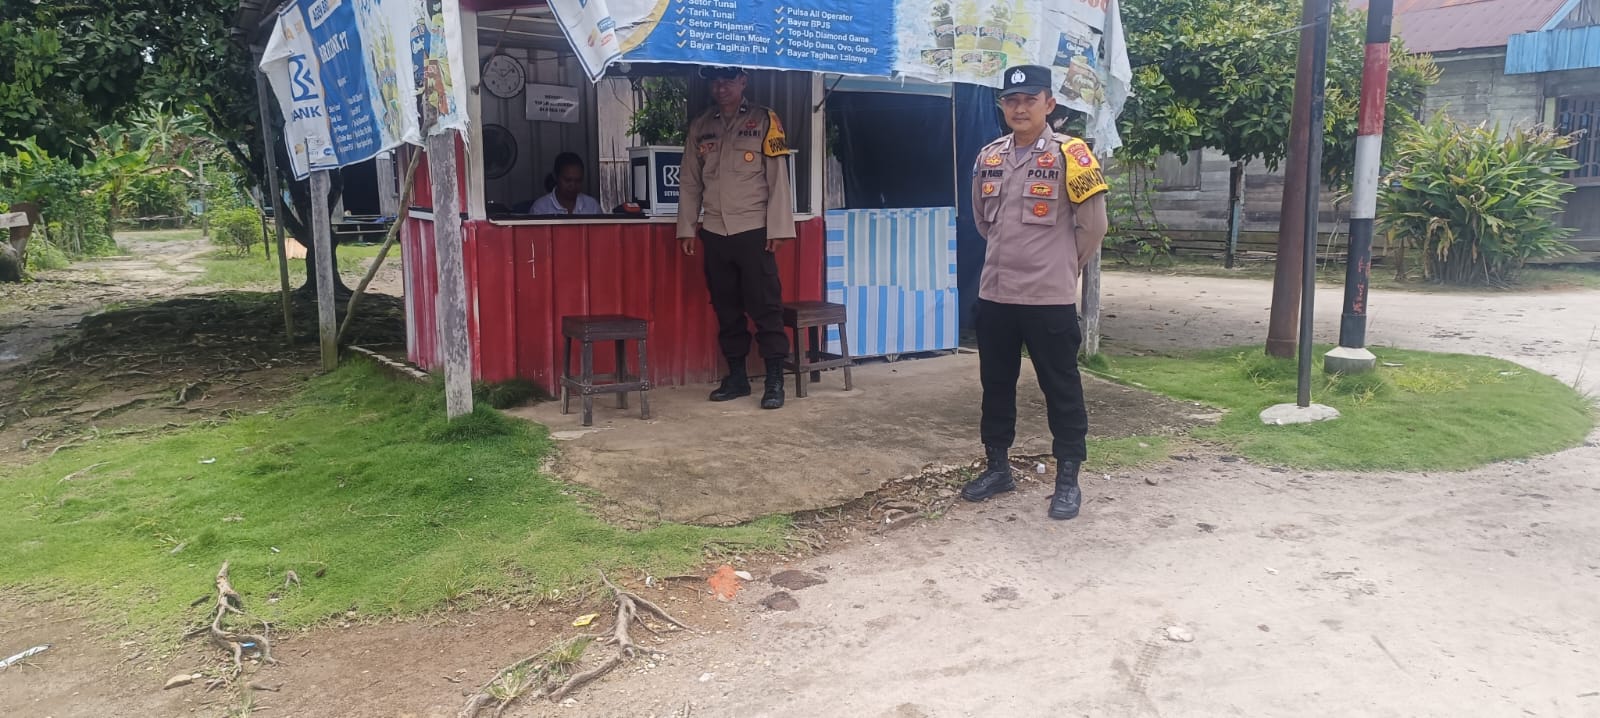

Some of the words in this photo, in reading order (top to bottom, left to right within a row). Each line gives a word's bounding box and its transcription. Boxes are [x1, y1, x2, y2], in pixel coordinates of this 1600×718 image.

[714, 0, 736, 8] Tunai
[688, 8, 709, 16] Tarik
[712, 10, 735, 19] Tunai
[788, 8, 808, 16] Pulsa
[822, 12, 853, 21] Operator
[689, 19, 712, 27] Setor
[714, 21, 754, 31] Pinjaman
[788, 18, 809, 27] Bayar
[811, 21, 830, 29] BPJS
[690, 30, 713, 40] Bayar
[716, 33, 746, 41] Cicilan
[748, 35, 771, 43] Motor
[788, 29, 813, 37] Top-Up
[816, 31, 847, 40] Diamond
[690, 41, 713, 51] Bayar
[715, 43, 750, 52] Tagihan
[788, 39, 813, 48] Top-Up
[816, 42, 835, 50] Dana,
[837, 44, 853, 52] Ovo,
[856, 46, 878, 55] Gopay
[788, 49, 809, 58] Bayar
[811, 52, 838, 61] Tagihan
[840, 54, 867, 63] Lainnya
[1028, 170, 1058, 180] POLRI
